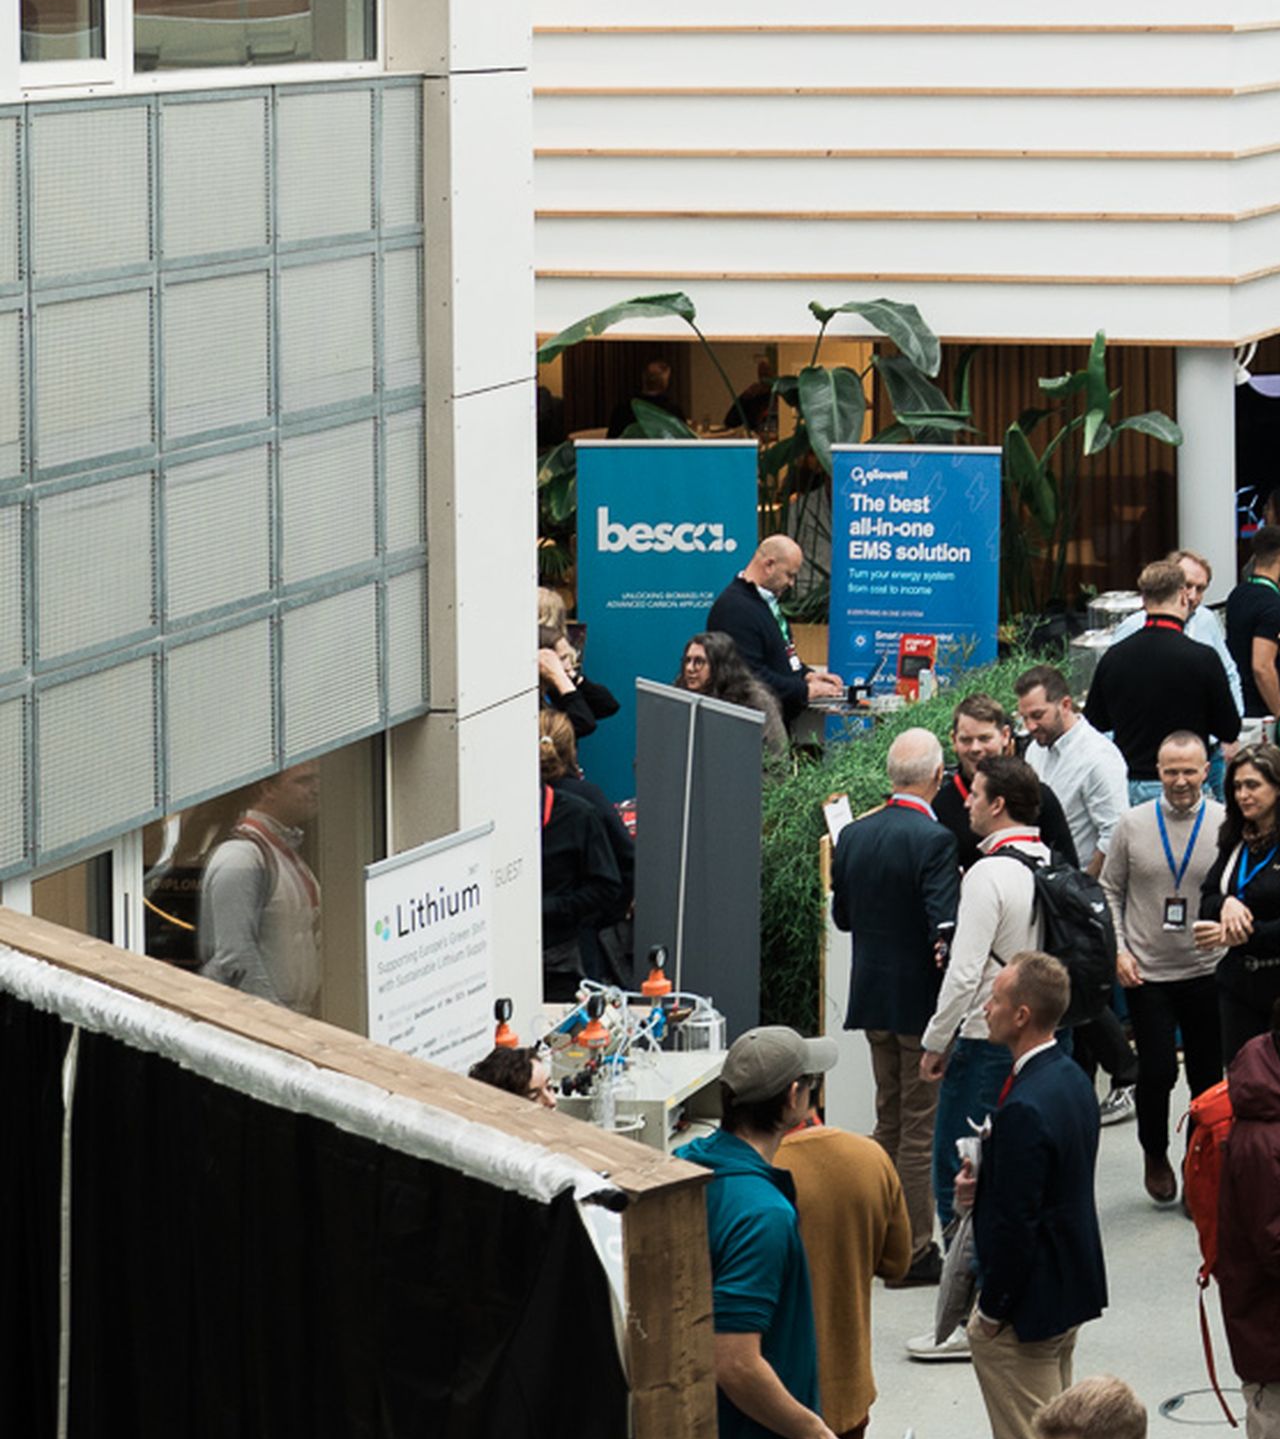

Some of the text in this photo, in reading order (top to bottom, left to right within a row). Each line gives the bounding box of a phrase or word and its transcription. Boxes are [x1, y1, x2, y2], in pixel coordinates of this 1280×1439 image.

[850, 493, 931, 514] The best
[849, 516, 935, 538] all-in-one
[849, 540, 971, 563] EMS solution
[870, 570, 889, 582] your
[891, 570, 922, 583] energy
[923, 571, 956, 583] system
[899, 584, 933, 596] income
[396, 882, 481, 938] Lithium
